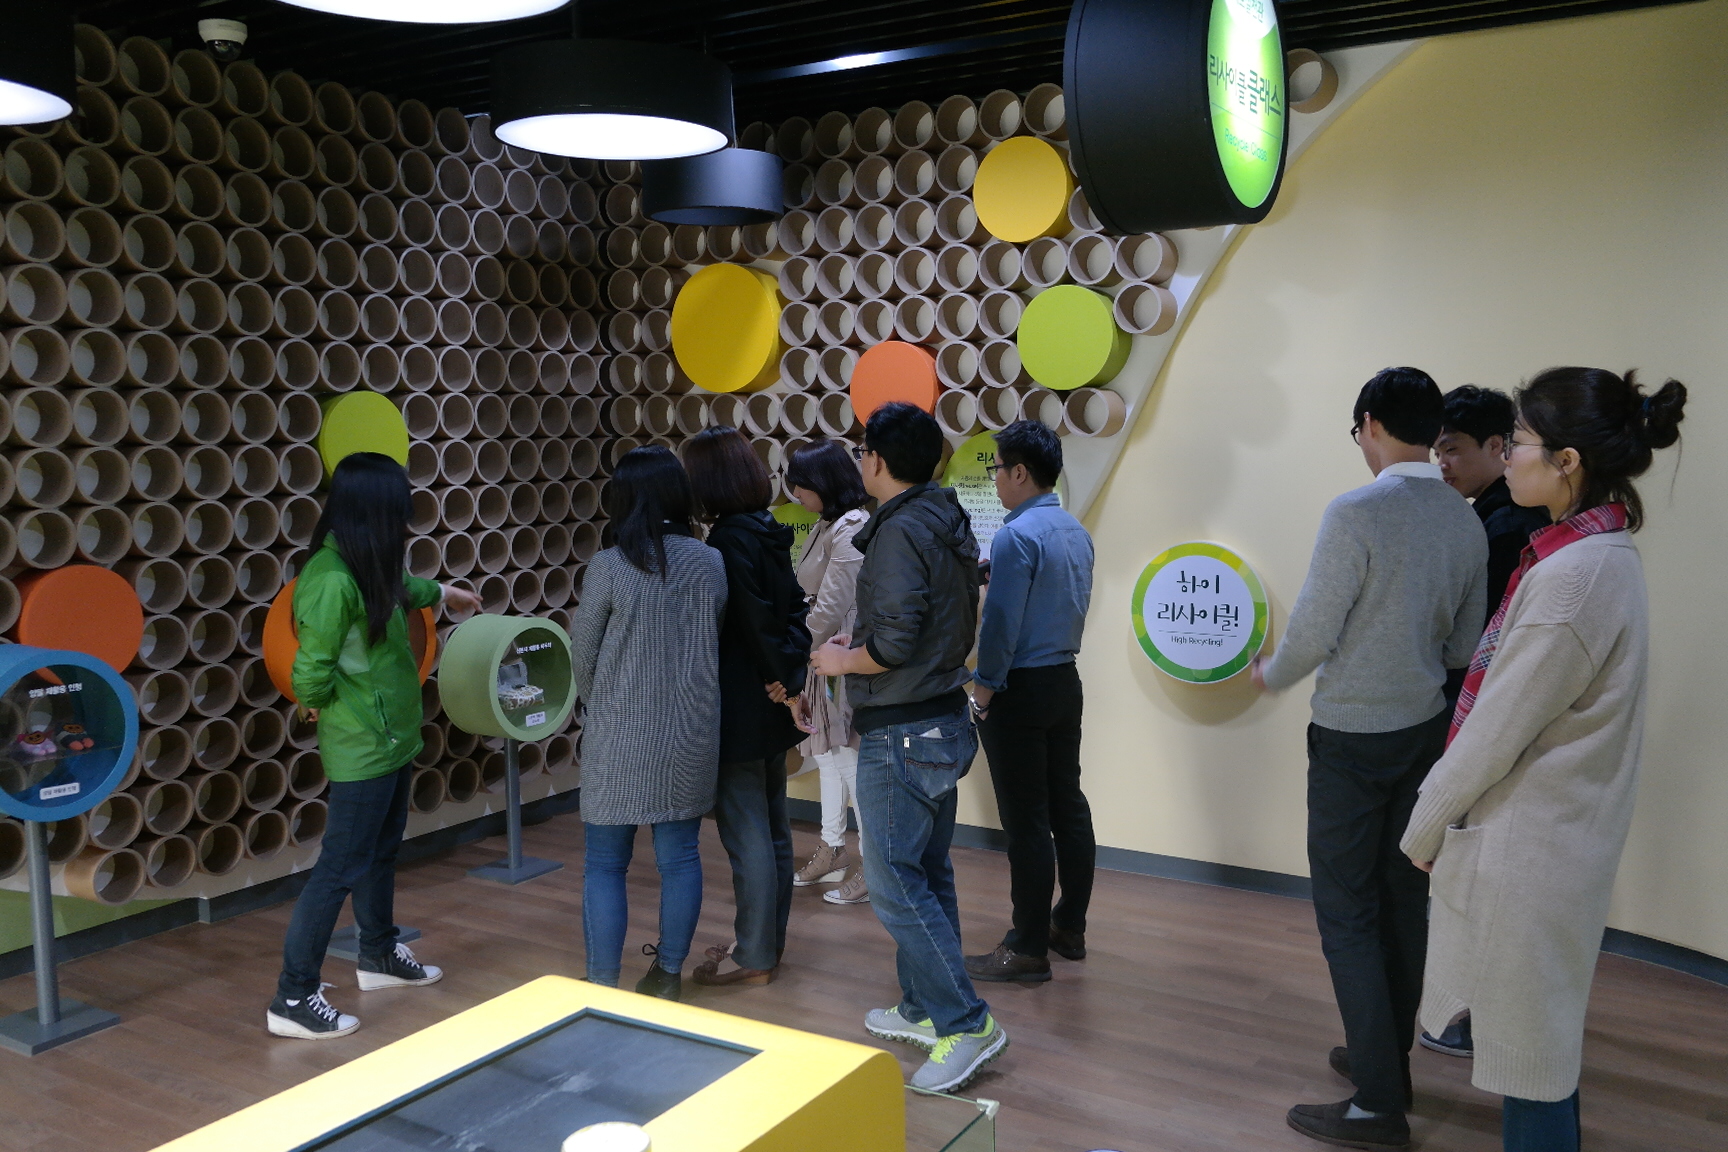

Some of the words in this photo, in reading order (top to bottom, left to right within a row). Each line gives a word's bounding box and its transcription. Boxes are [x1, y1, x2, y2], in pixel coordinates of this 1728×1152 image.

[1176, 570, 1220, 594] 하이
[1157, 601, 1239, 632] 리사이클!
[1171, 635, 1187, 645] High
[1188, 637, 1223, 648] Recycling!
